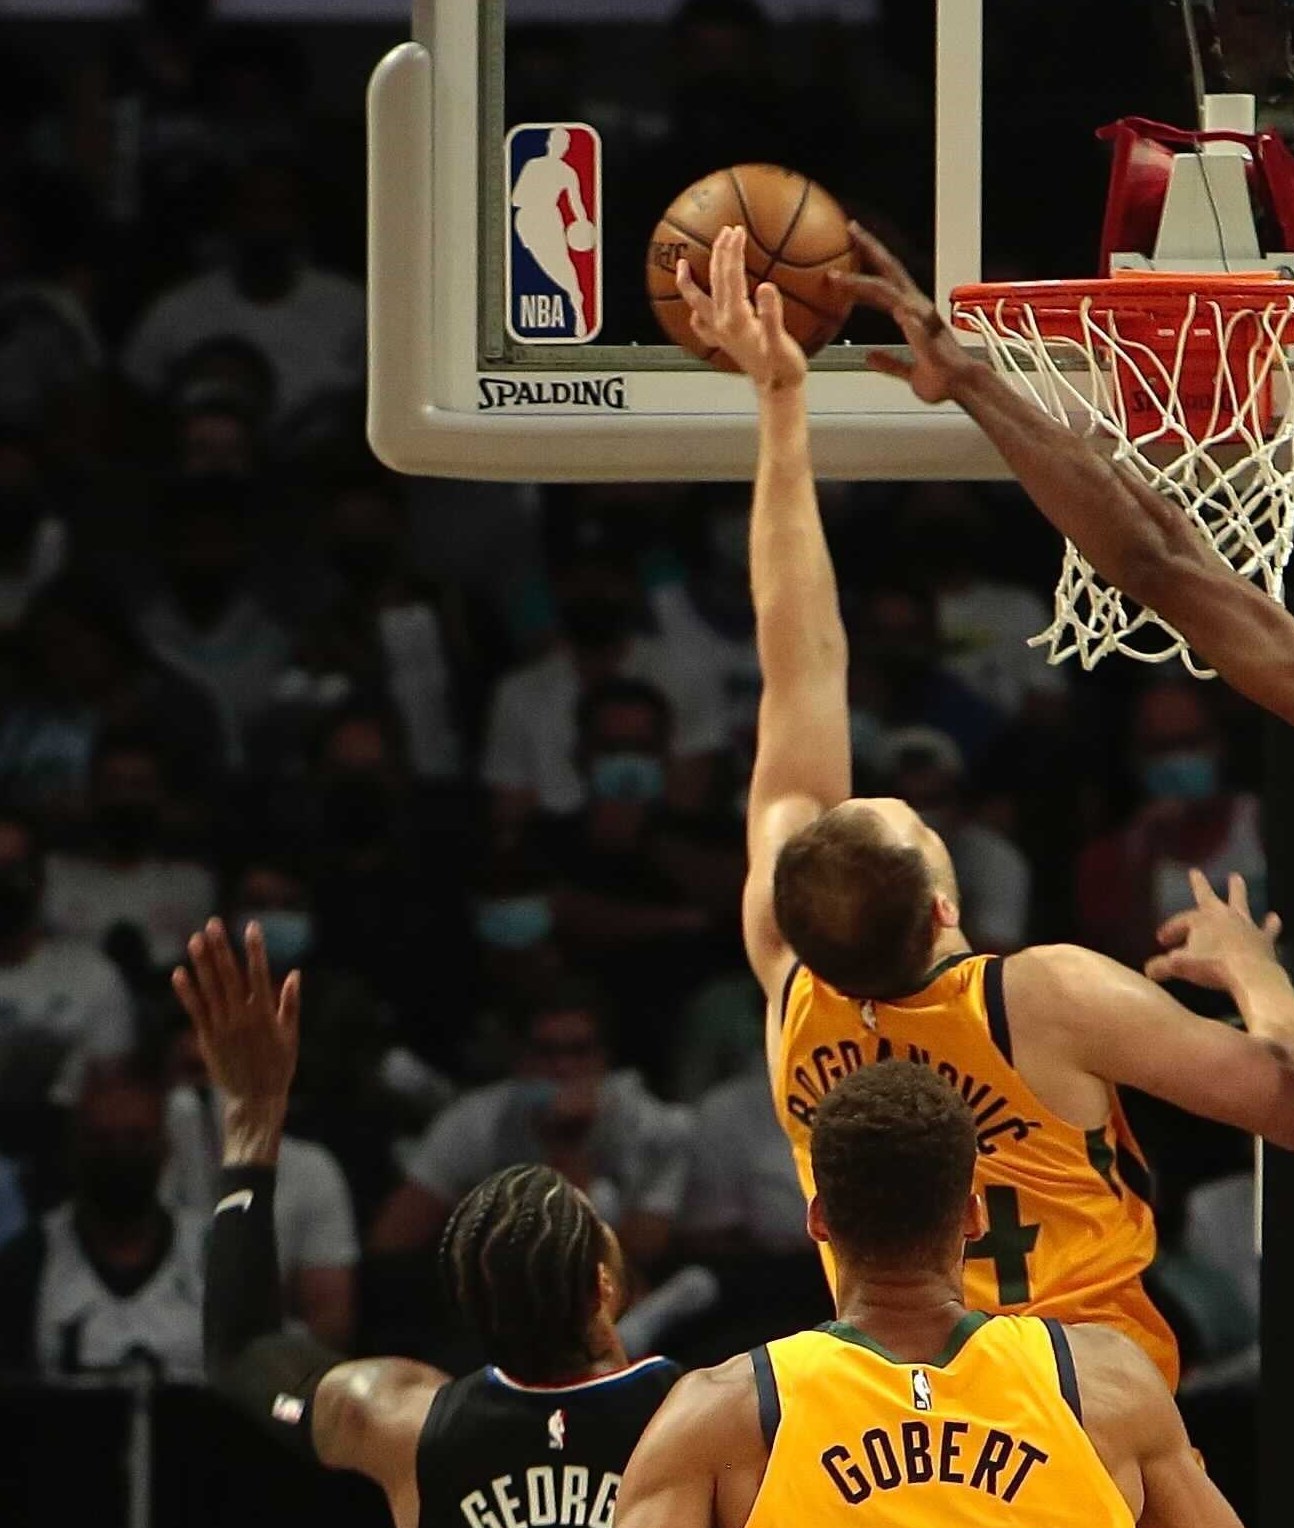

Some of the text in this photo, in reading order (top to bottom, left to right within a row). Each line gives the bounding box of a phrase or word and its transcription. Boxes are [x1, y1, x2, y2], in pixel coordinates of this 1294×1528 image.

[520, 293, 567, 330] NBA
[477, 376, 626, 410] SPALDING
[820, 1420, 1049, 1506] GOBERT
